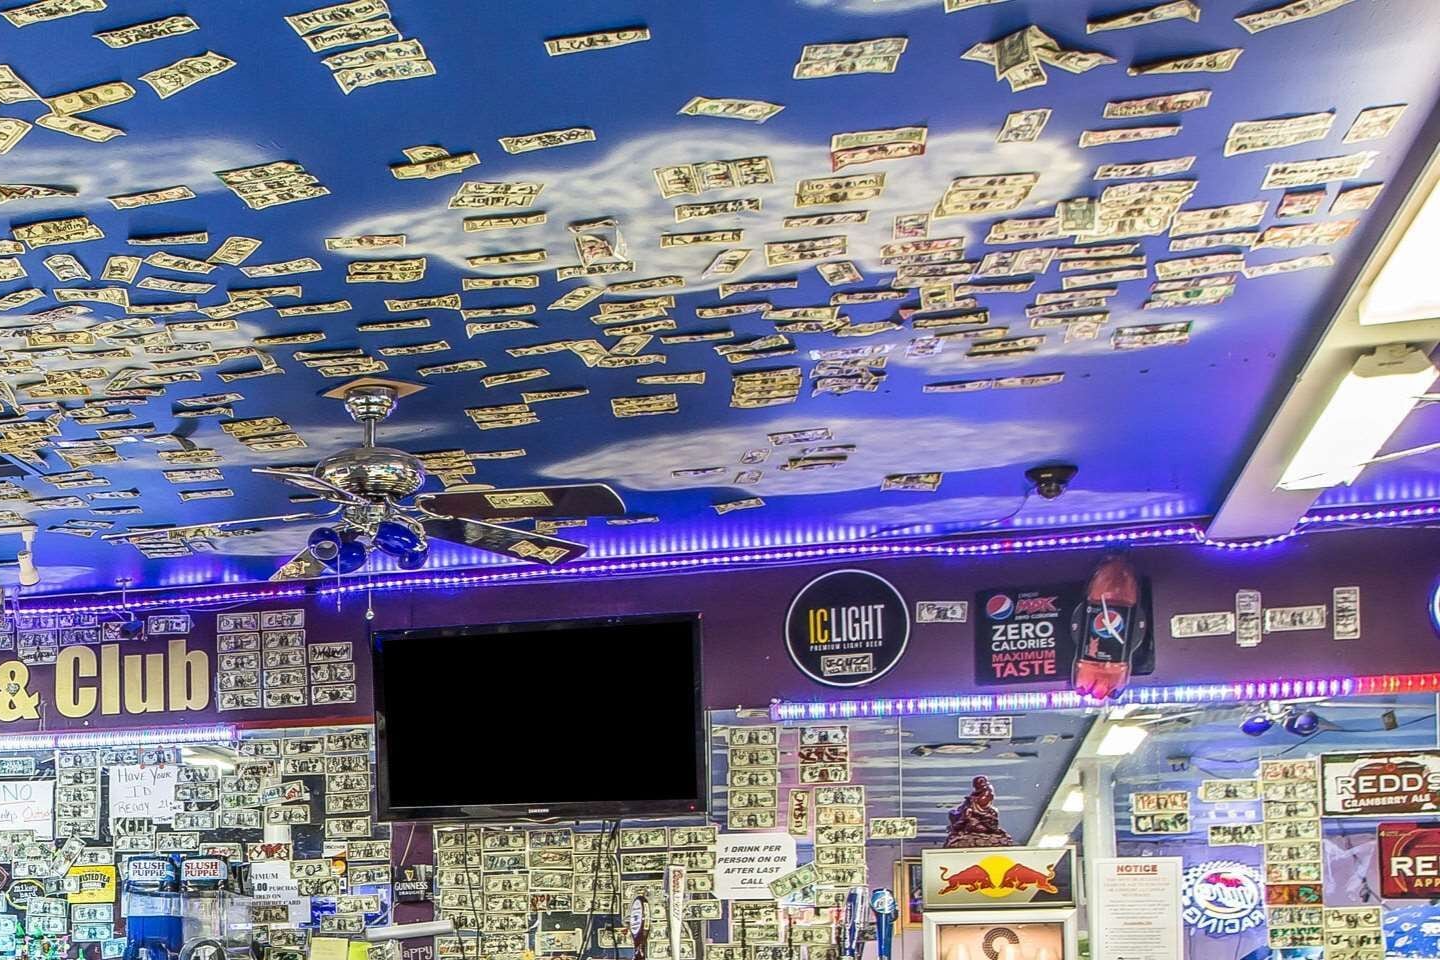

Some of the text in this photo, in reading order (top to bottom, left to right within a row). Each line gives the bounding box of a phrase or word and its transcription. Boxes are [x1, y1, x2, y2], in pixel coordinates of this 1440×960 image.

[991, 621, 1054, 641] ZERO
[991, 637, 1056, 652] CALORIES
[991, 650, 1056, 663] MAXIMUM
[991, 660, 1057, 679] TASTE
[56, 640, 210, 719] Club
[1335, 772, 1440, 796] REDD'S
[2, 783, 33, 801] NO
[1344, 794, 1431, 808] CRANBERRY ALE
[731, 845, 761, 853] DRINK
[763, 844, 781, 852] PER
[718, 856, 755, 864] PERSON
[773, 855, 787, 863] OR
[132, 861, 165, 870] SLUSH
[184, 861, 219, 870] SLUSH
[756, 866, 780, 874] LAST
[1116, 864, 1158, 873] NOTICE
[394, 881, 428, 891] GUINNESS
[740, 877, 765, 885] CALL
